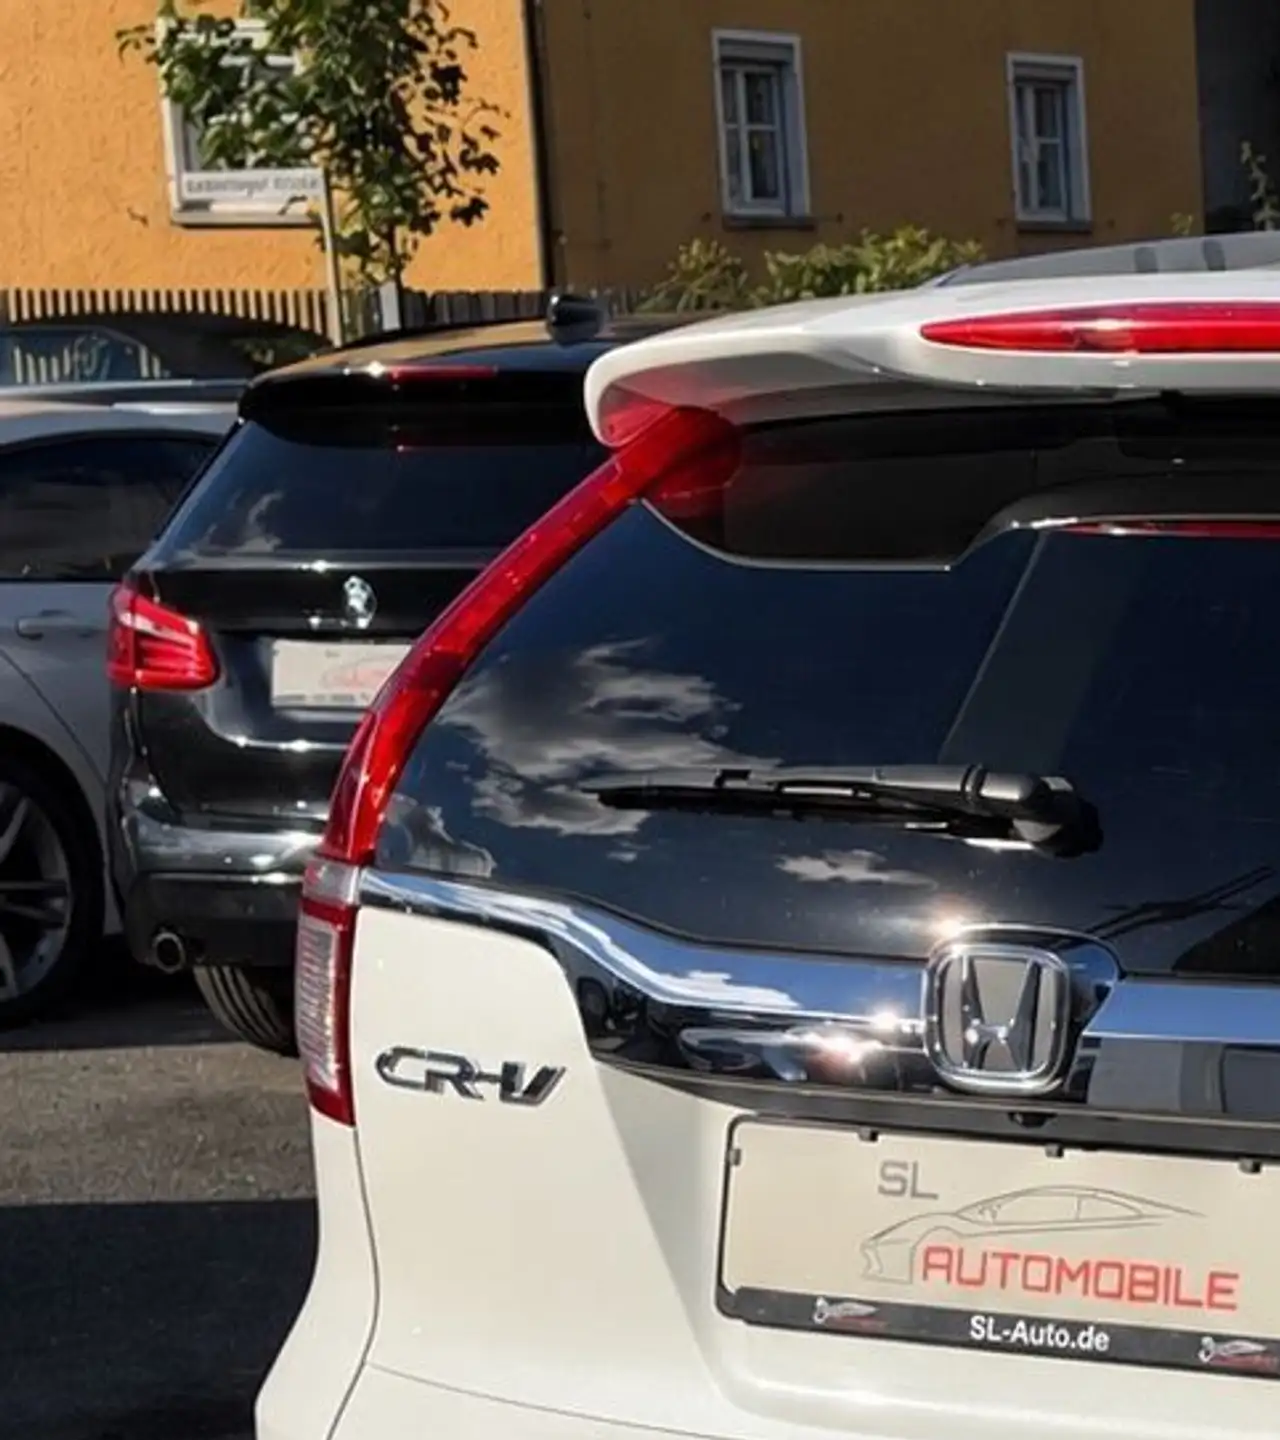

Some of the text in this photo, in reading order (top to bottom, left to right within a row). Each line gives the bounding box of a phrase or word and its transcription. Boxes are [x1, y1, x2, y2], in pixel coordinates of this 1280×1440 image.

[374, 1045, 567, 1107] CR-V
[877, 1160, 939, 1201] SL
[922, 1245, 1239, 1311] AUTOMOBILE
[969, 1314, 1110, 1352] SL-Auto.de
